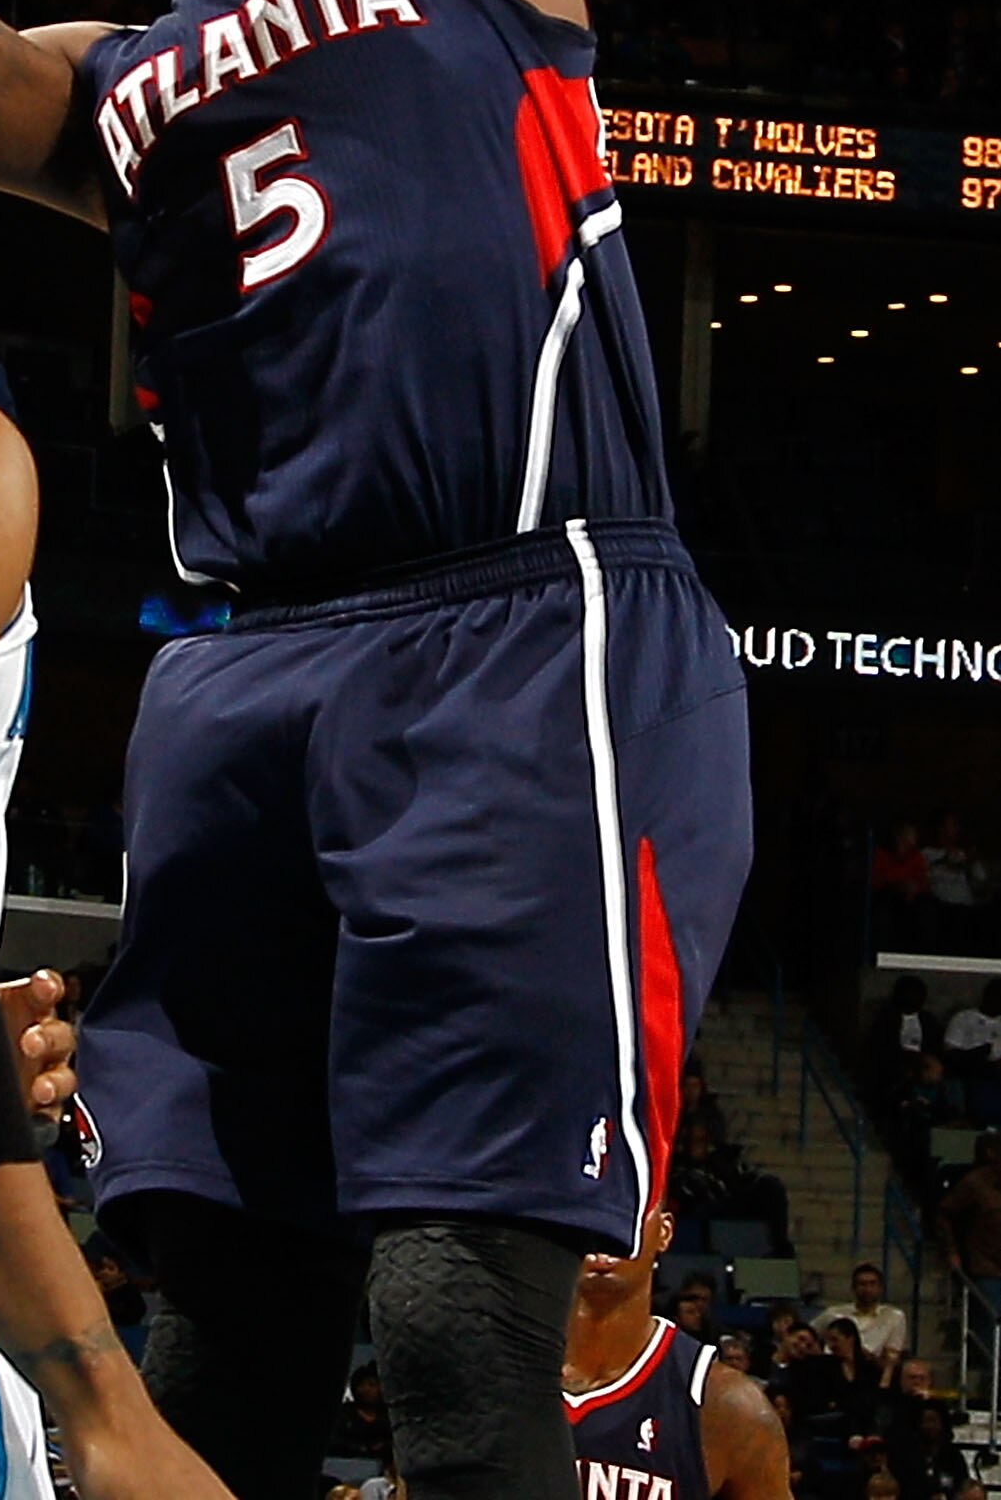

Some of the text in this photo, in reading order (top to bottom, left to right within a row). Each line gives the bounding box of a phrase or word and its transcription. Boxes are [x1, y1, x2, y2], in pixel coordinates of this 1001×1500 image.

[714, 116, 877, 160] T'WOLVES
[961, 135, 1001, 169] 98
[220, 116, 334, 294] 5
[606, 150, 1001, 210] LAND CAVALIERS 97
[575, 1459, 674, 1500] NTA
